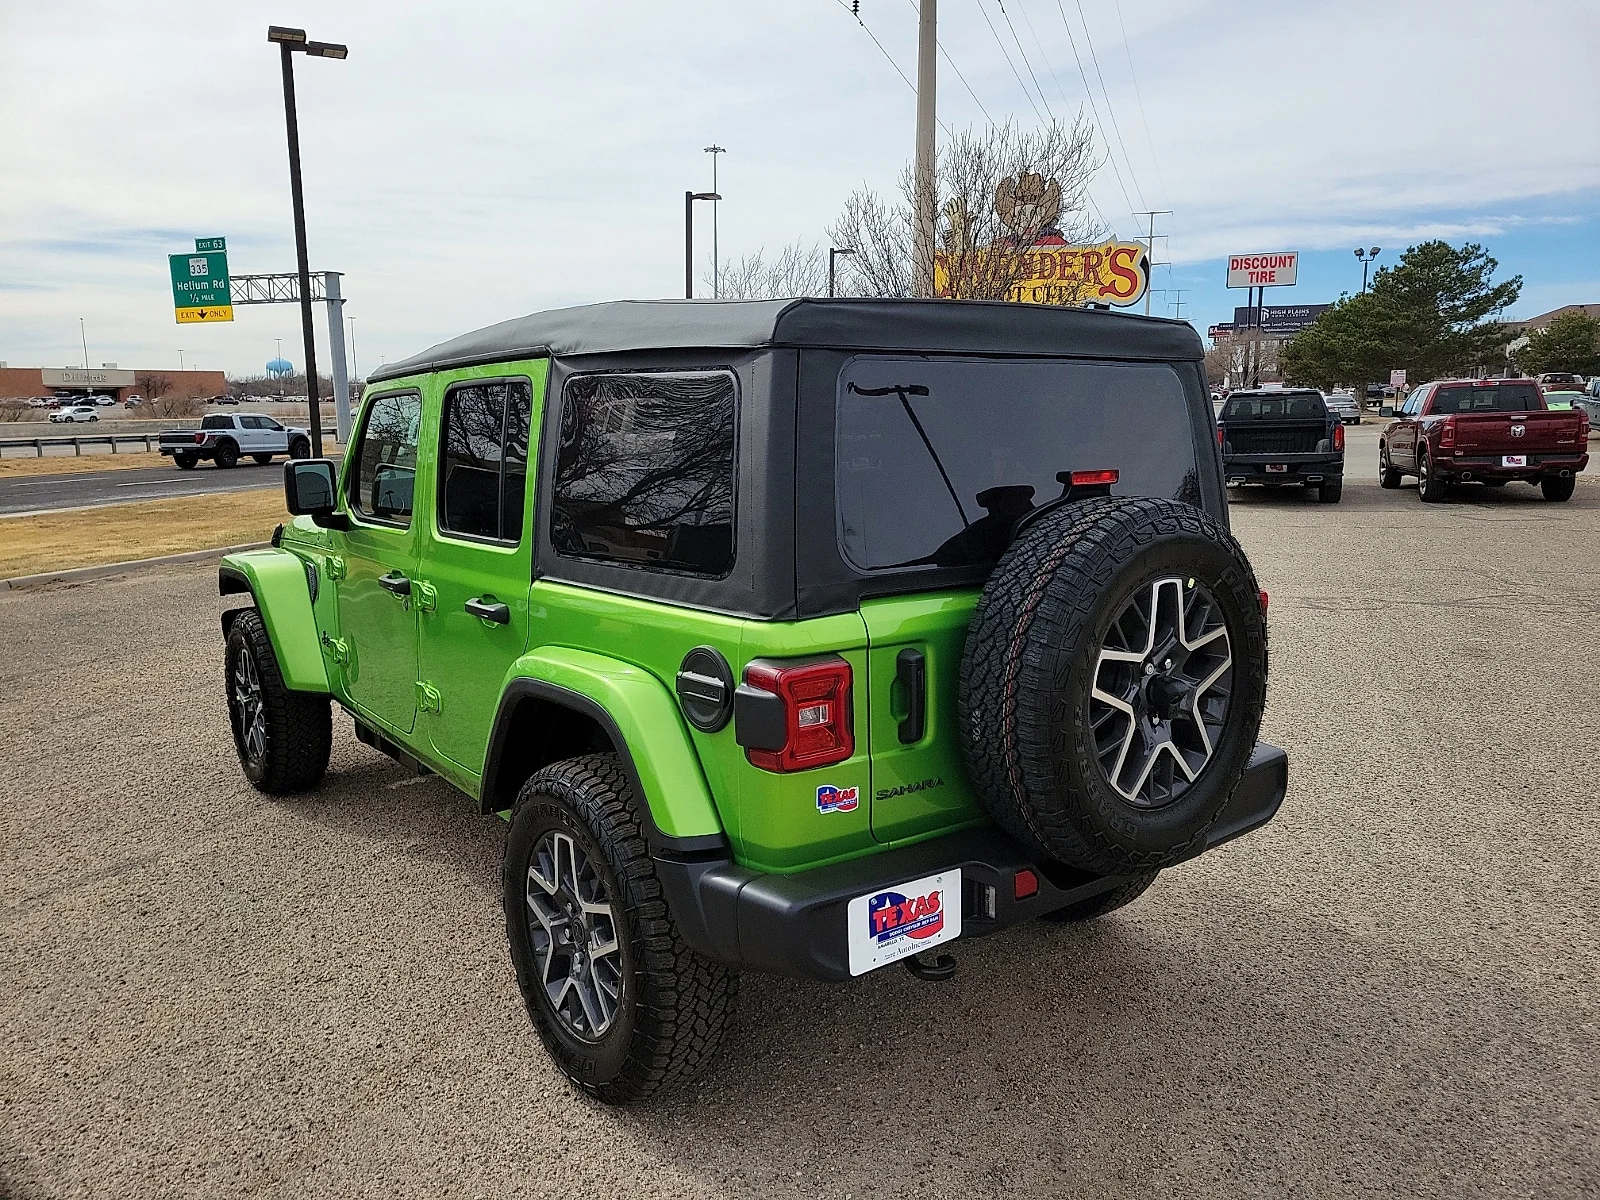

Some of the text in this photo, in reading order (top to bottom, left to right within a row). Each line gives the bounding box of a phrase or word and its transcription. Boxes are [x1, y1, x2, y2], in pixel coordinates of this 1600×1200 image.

[199, 240, 223, 249] EXIT 63
[190, 264, 208, 275] 335
[1230, 255, 1295, 271] DISCOUNT
[1248, 270, 1276, 284] TIRE
[177, 279, 225, 291] Helium Rd
[210, 310, 227, 318] ONLY
[876, 777, 944, 800] SAHARA
[821, 788, 856, 804] TEXAS
[873, 891, 941, 933] TEXAS
